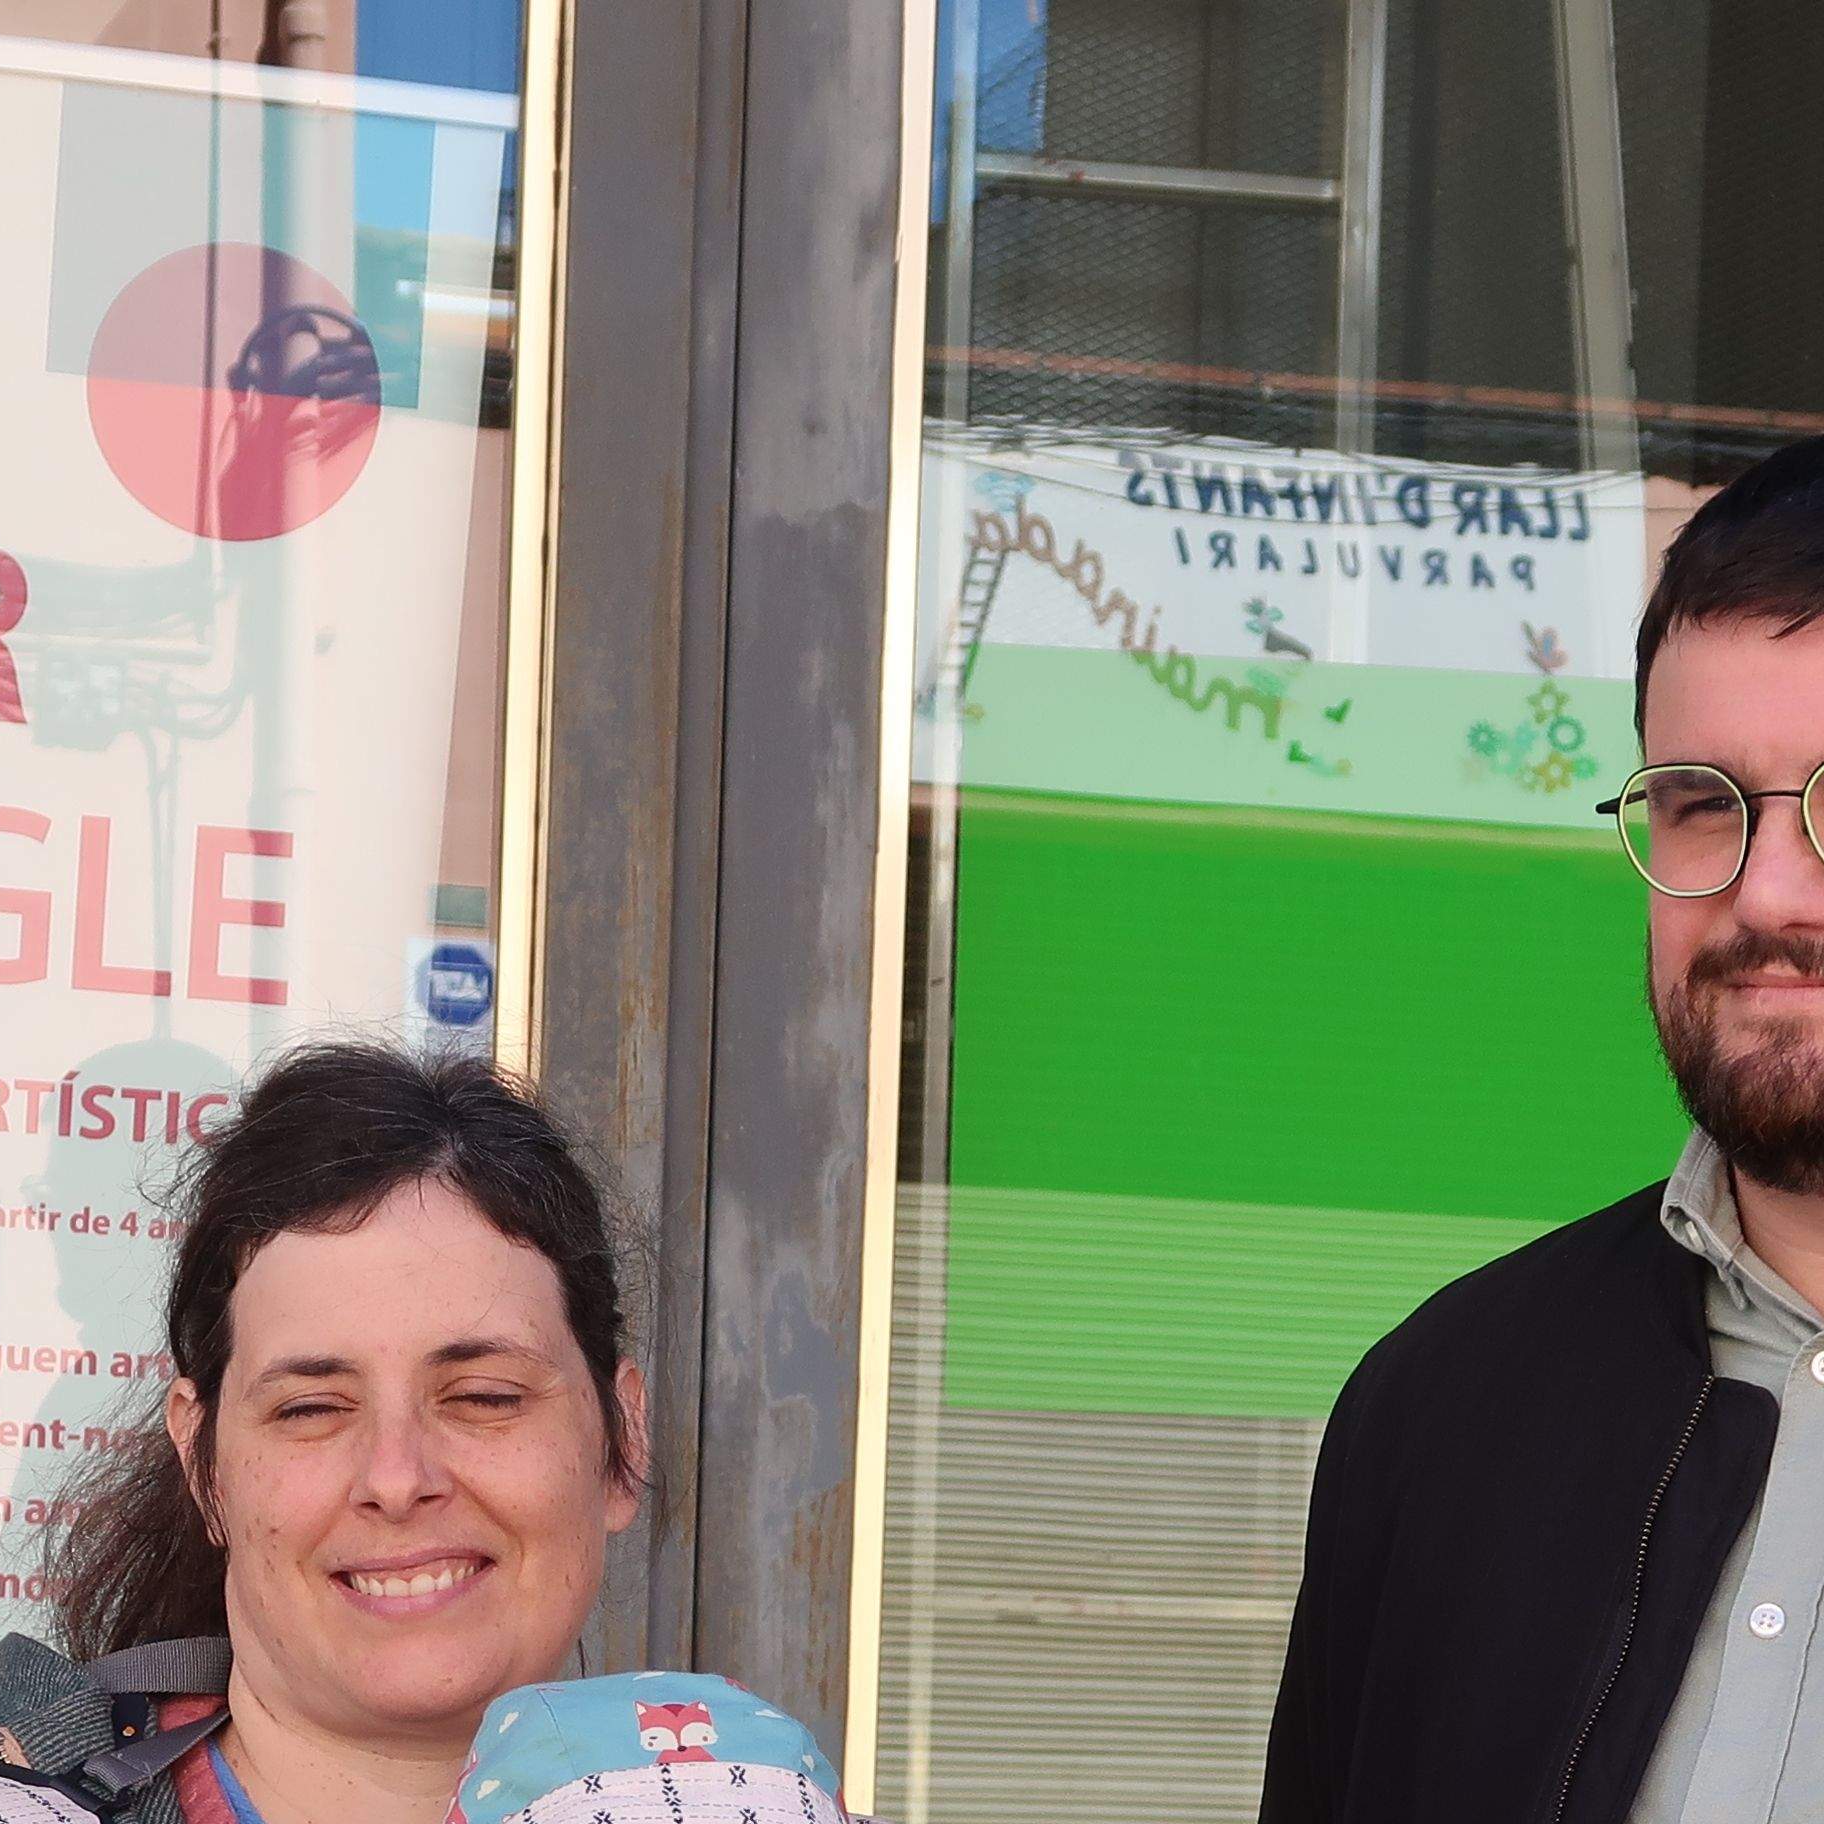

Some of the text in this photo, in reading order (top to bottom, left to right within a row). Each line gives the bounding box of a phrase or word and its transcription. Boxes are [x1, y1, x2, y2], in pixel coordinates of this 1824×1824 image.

[69, 1205, 111, 1236] de
[119, 1210, 140, 1237] 4
[110, 1352, 175, 1380] art
